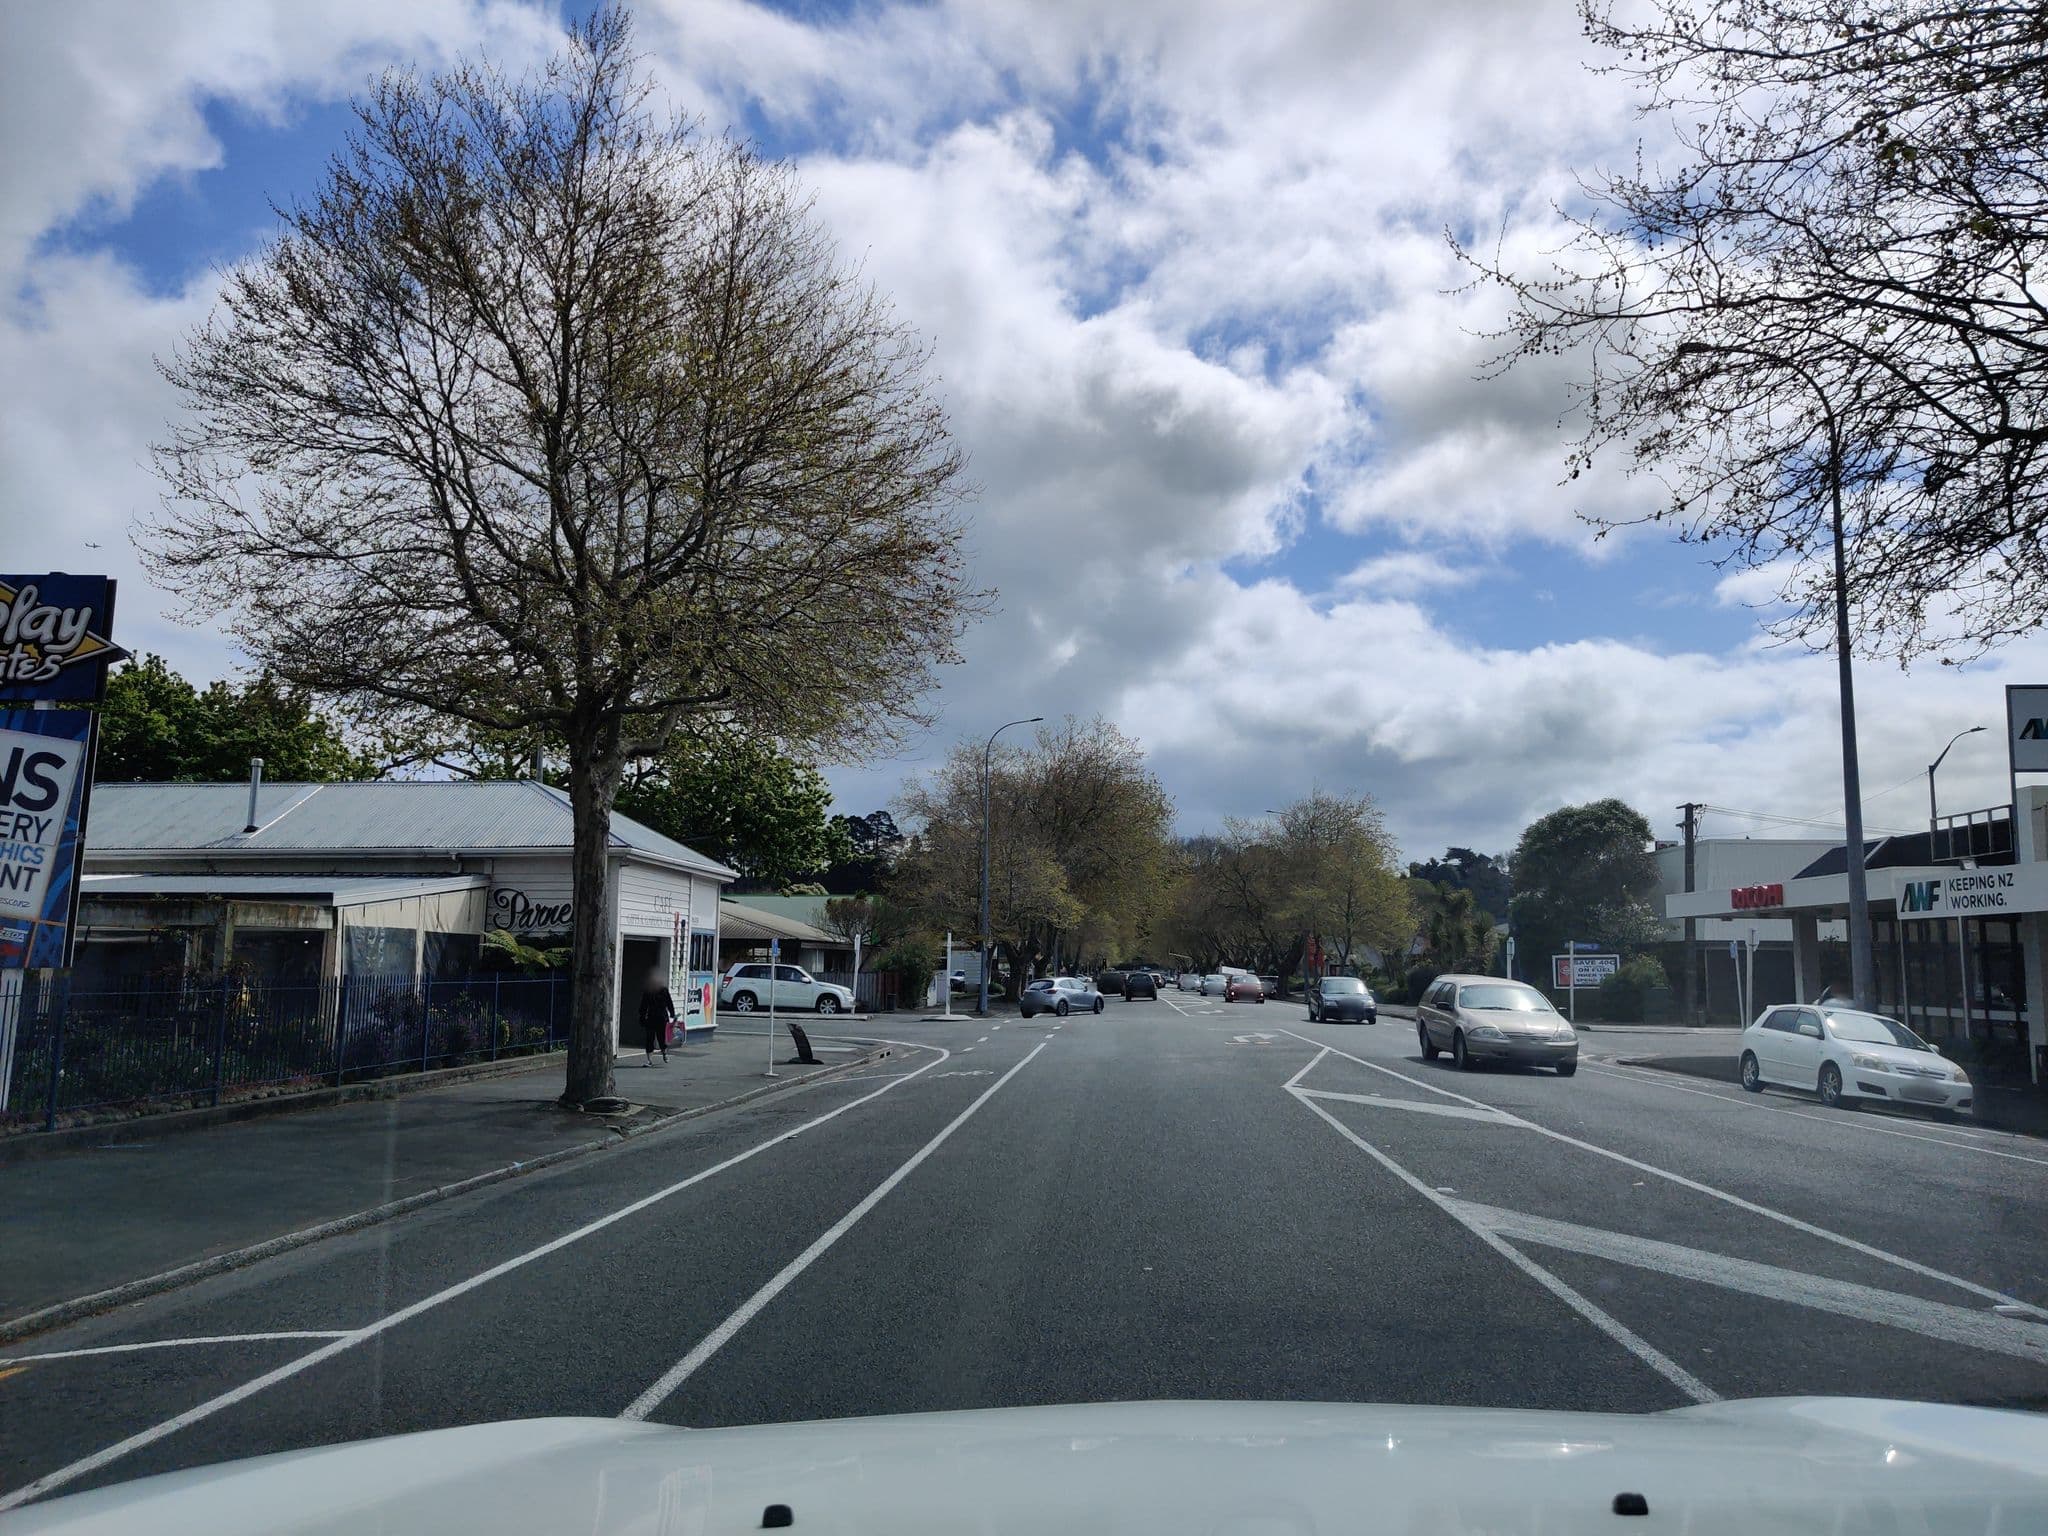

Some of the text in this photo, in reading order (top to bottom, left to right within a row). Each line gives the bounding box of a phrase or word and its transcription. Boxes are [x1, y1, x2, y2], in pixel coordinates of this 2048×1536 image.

[0, 584, 93, 654] lay
[1949, 872, 2014, 892] KEEPING NZ
[1950, 892, 2008, 910] WORKING.
